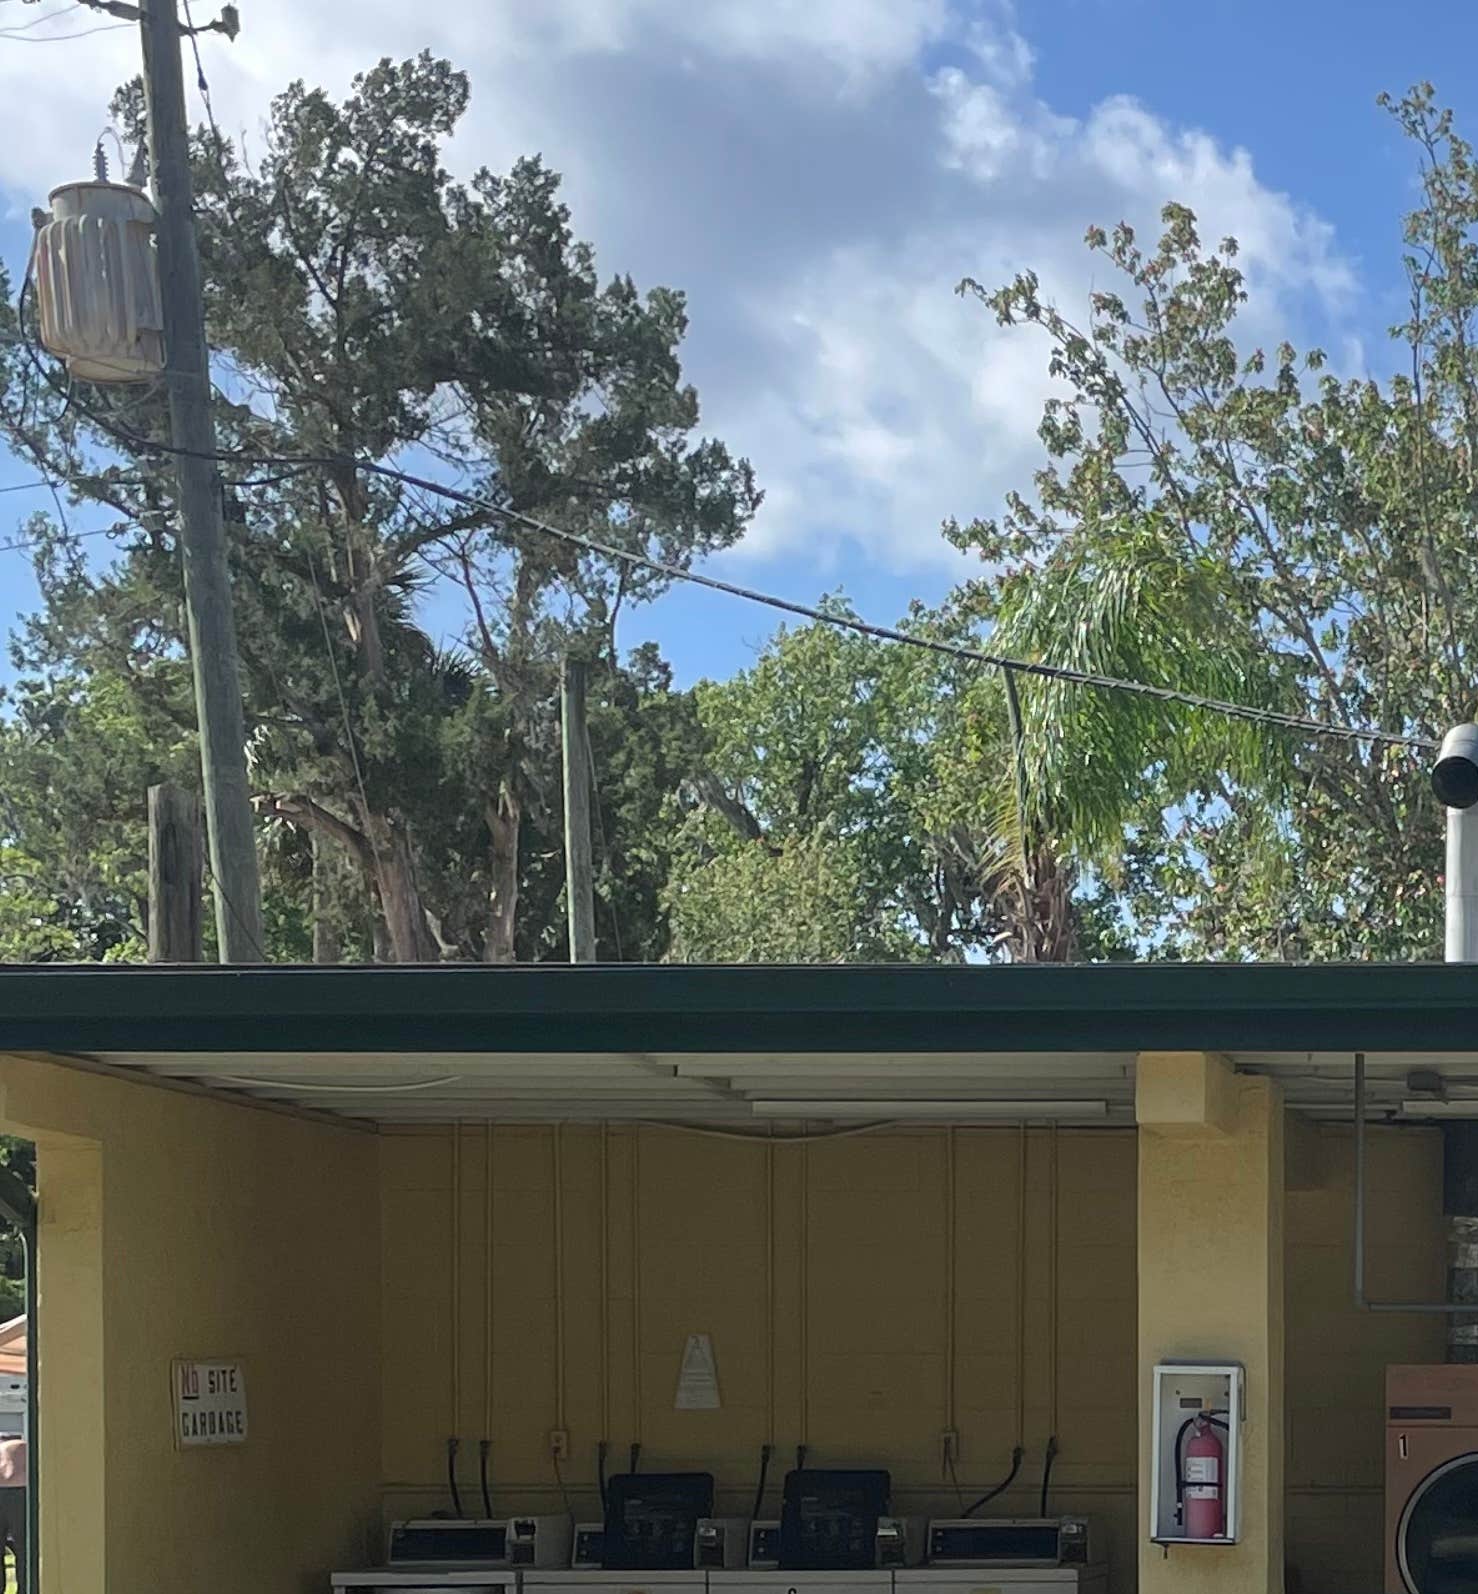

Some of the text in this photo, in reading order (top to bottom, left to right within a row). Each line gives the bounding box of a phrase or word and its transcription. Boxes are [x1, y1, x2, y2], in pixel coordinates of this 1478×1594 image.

[181, 1364, 237, 1395] NO SITE
[181, 1410, 243, 1437] GARBAGE
[1399, 1434, 1407, 1456] 1
